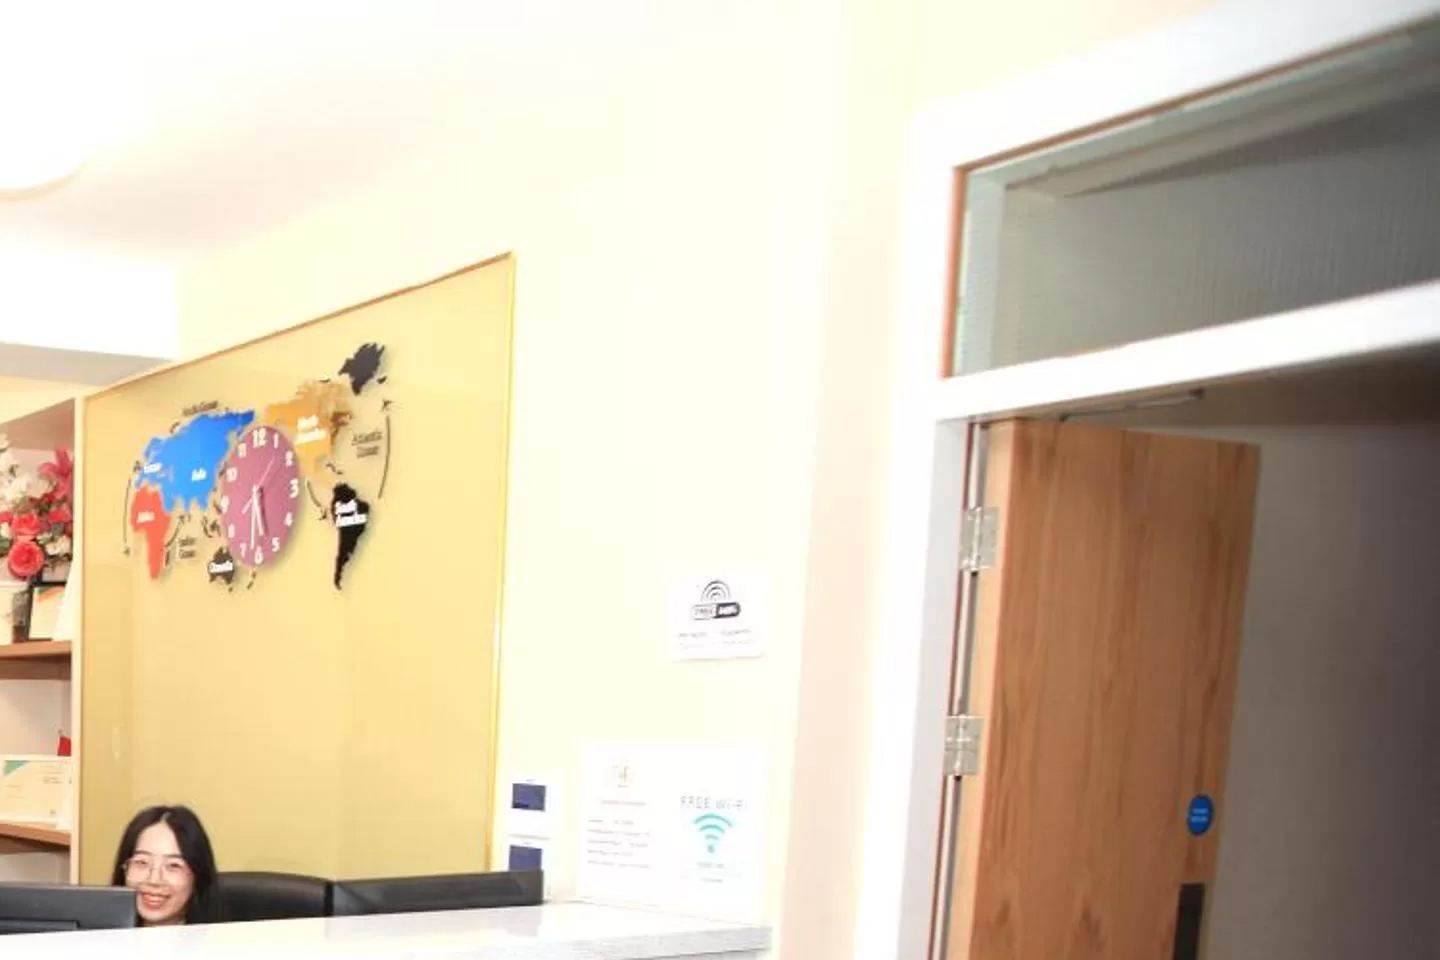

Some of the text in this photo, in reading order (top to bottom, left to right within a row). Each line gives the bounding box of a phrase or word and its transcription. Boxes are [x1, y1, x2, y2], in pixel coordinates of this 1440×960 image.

[252, 428, 267, 449] 12
[273, 433, 279, 449] 1
[237, 442, 247, 458] 11
[285, 450, 294, 467] 2
[226, 467, 237, 482] 10
[289, 478, 299, 498] 3
[220, 494, 229, 514] 9
[284, 511, 293, 526] 4
[227, 523, 235, 538] 8
[239, 542, 247, 557] 7
[271, 537, 280, 552] 5
[254, 545, 263, 565] 6
